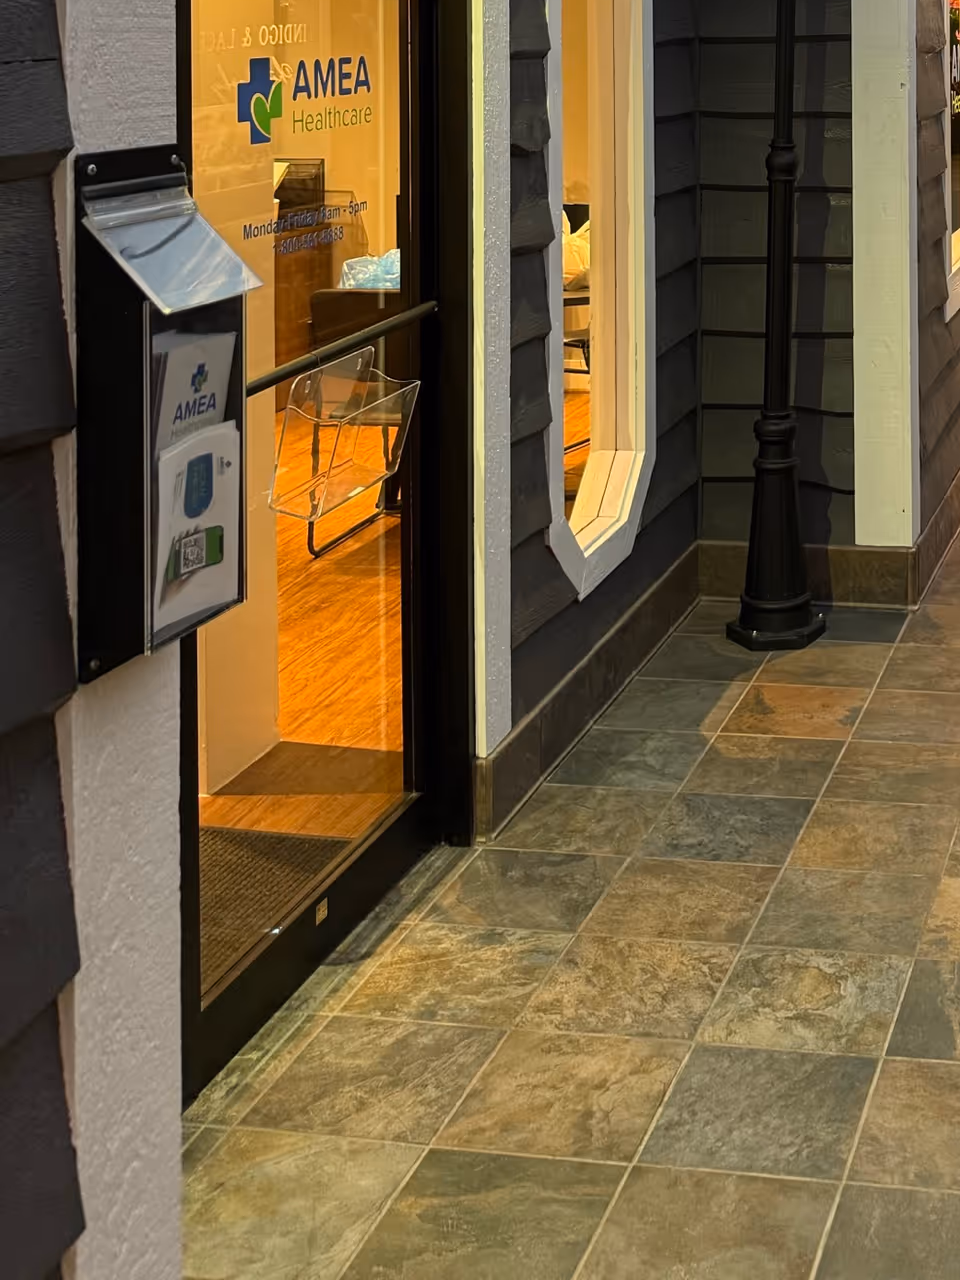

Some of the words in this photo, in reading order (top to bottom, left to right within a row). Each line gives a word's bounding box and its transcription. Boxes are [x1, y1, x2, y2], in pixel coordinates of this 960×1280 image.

[292, 55, 371, 101] AMEA
[292, 106, 373, 134] Healthcare
[348, 201, 368, 216] 5pm
[173, 392, 217, 425] AMEA
